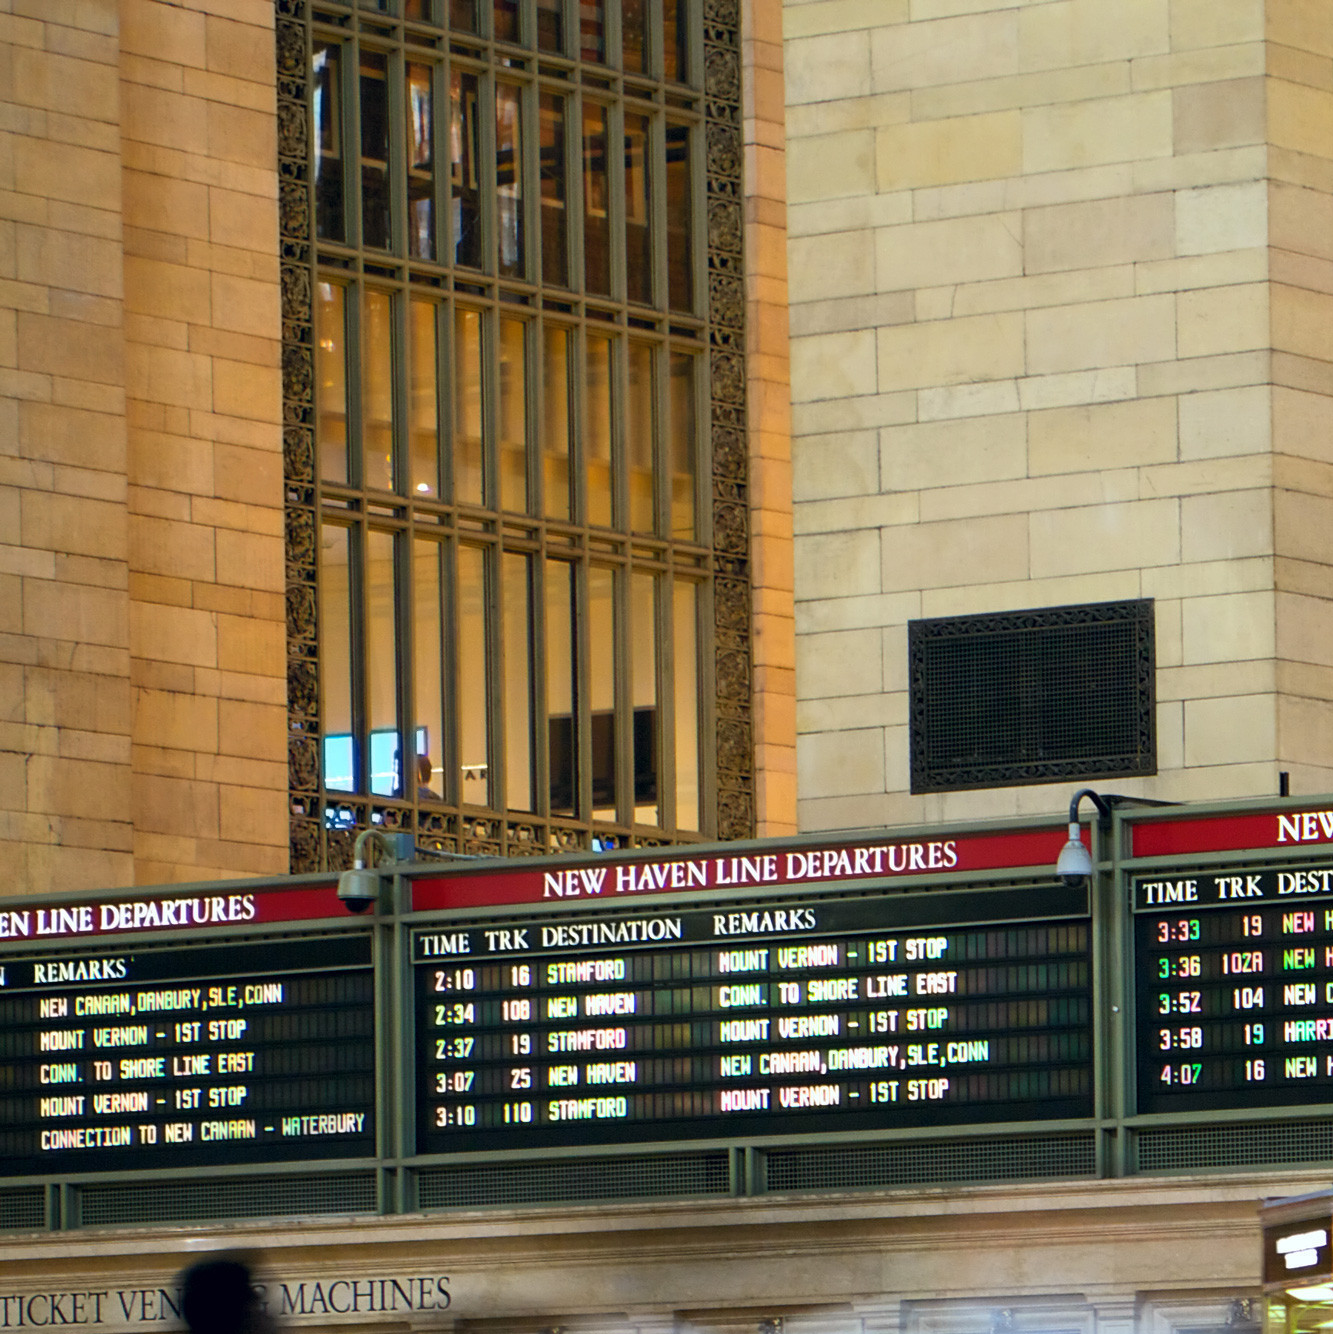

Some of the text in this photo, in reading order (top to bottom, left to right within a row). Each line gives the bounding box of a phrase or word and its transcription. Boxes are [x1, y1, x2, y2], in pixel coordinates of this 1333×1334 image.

[543, 841, 958, 897] NEW HAVEN LINE DEPARTURES
[1143, 880, 1198, 904] TIME
[1214, 875, 1264, 899] TRK
[0, 894, 256, 938] EN LINE DEPARTURES
[420, 908, 816, 956] TIME TRK DESTINATION REMARKS
[1157, 919, 1200, 942] 3:33
[1243, 915, 1262, 937] 19
[1282, 912, 1314, 934] NEW
[33, 958, 127, 984] REMARKS
[435, 937, 948, 991] 2:10 16 STAMFORD MOUNT VERNON 1ST STOP
[1158, 956, 1201, 979] 3:36
[1222, 952, 1263, 975] 102A
[1283, 948, 1315, 970] NEW
[40, 983, 283, 1018] NEW CANAAN,DANBURY,SLE,CONN
[435, 971, 957, 1026] 2:34 108 NEW HAVEN CONN. TO SHORE LINE EAST
[1158, 992, 1202, 1015] 3:52
[1233, 987, 1264, 1010] 104
[1283, 983, 1316, 1005] NEW
[40, 1019, 247, 1051] MOUNT VERNON 1ST STOP
[435, 1008, 948, 1060] 2:37 19 STAMFORD MOUNT VERNON 1ST STOP
[1159, 1027, 1202, 1050] 3:58
[1244, 1023, 1264, 1045] 19
[40, 1052, 255, 1084] CONN. TO SHORE LINE EAST
[436, 1040, 989, 1093] 3:07 25 NEW HAVEN NEW CANAAN,DANBURY,SLE,CONN
[1160, 1063, 1202, 1086] 4:07
[1245, 1058, 1265, 1081] 16
[1285, 1057, 1317, 1079] NEW
[40, 1086, 248, 1118] MOUNT VERNON 1ST STOP
[436, 1078, 949, 1128] 3:10 110 STAMFORD MOUNT VERNON 1ST STOP
[41, 1113, 366, 1150] CONNECTION TO NEW CANAAN WATERBURY
[1, 1276, 452, 1328] TICKET VENG MACHINES
